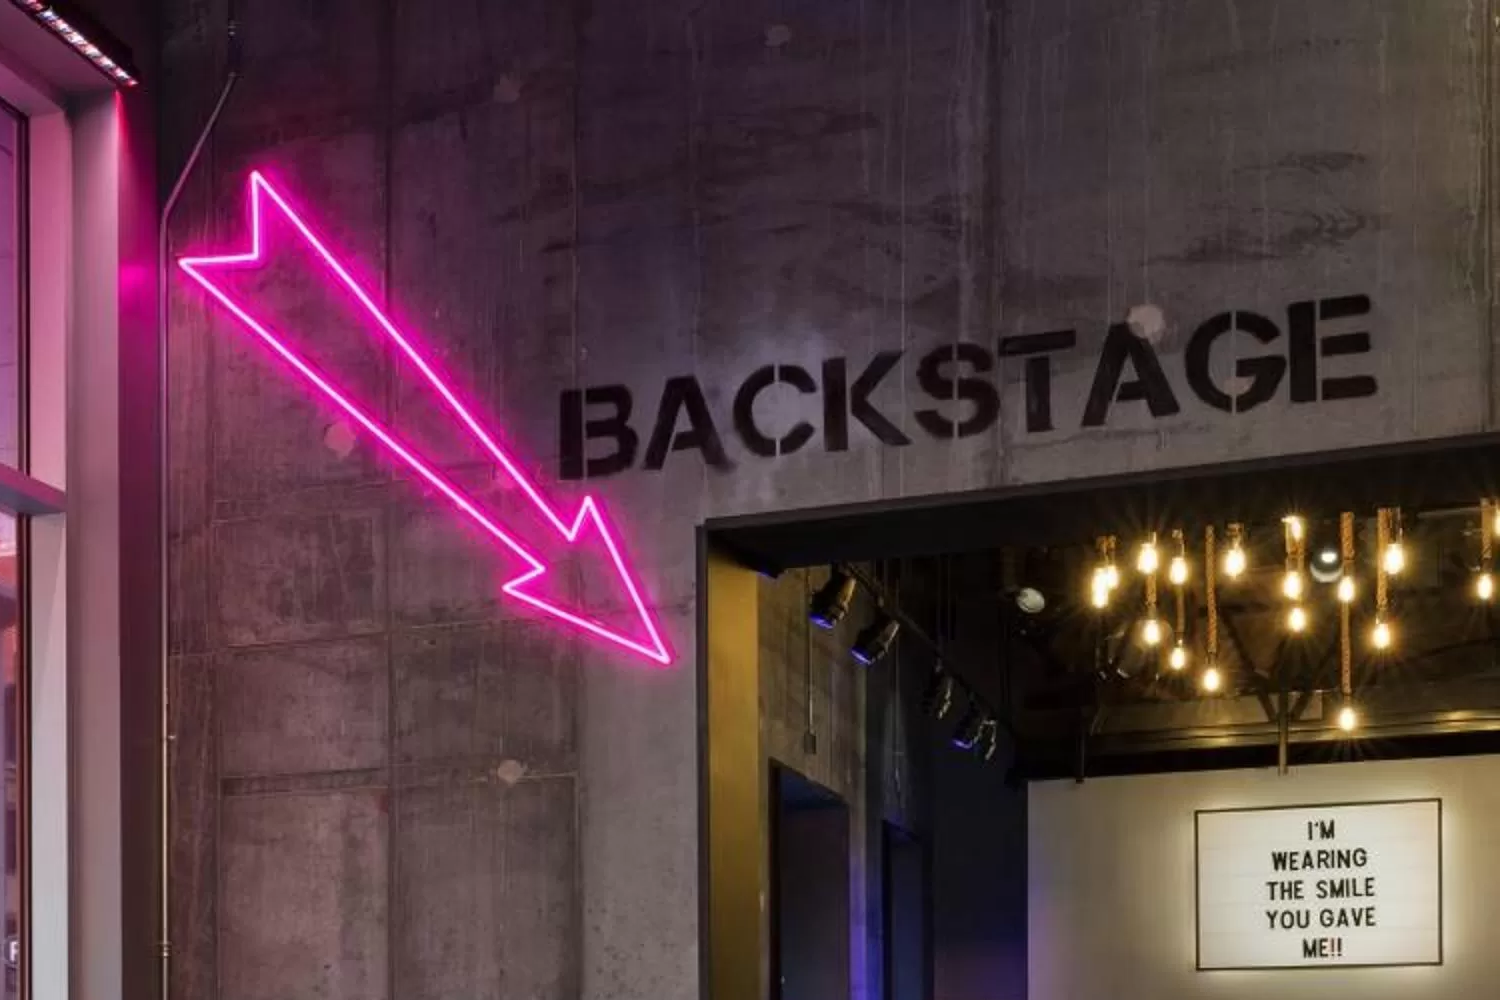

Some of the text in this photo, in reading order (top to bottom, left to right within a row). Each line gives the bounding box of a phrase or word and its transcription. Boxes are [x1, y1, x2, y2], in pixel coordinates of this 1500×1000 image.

[558, 294, 1378, 481] BACKSTAGE
[1307, 819, 1336, 840] I'M
[1271, 847, 1368, 871] WEARING
[1266, 876, 1375, 901] THE SMILE
[1266, 906, 1376, 930] YOU GAVE
[1302, 937, 1342, 959] ME!!
